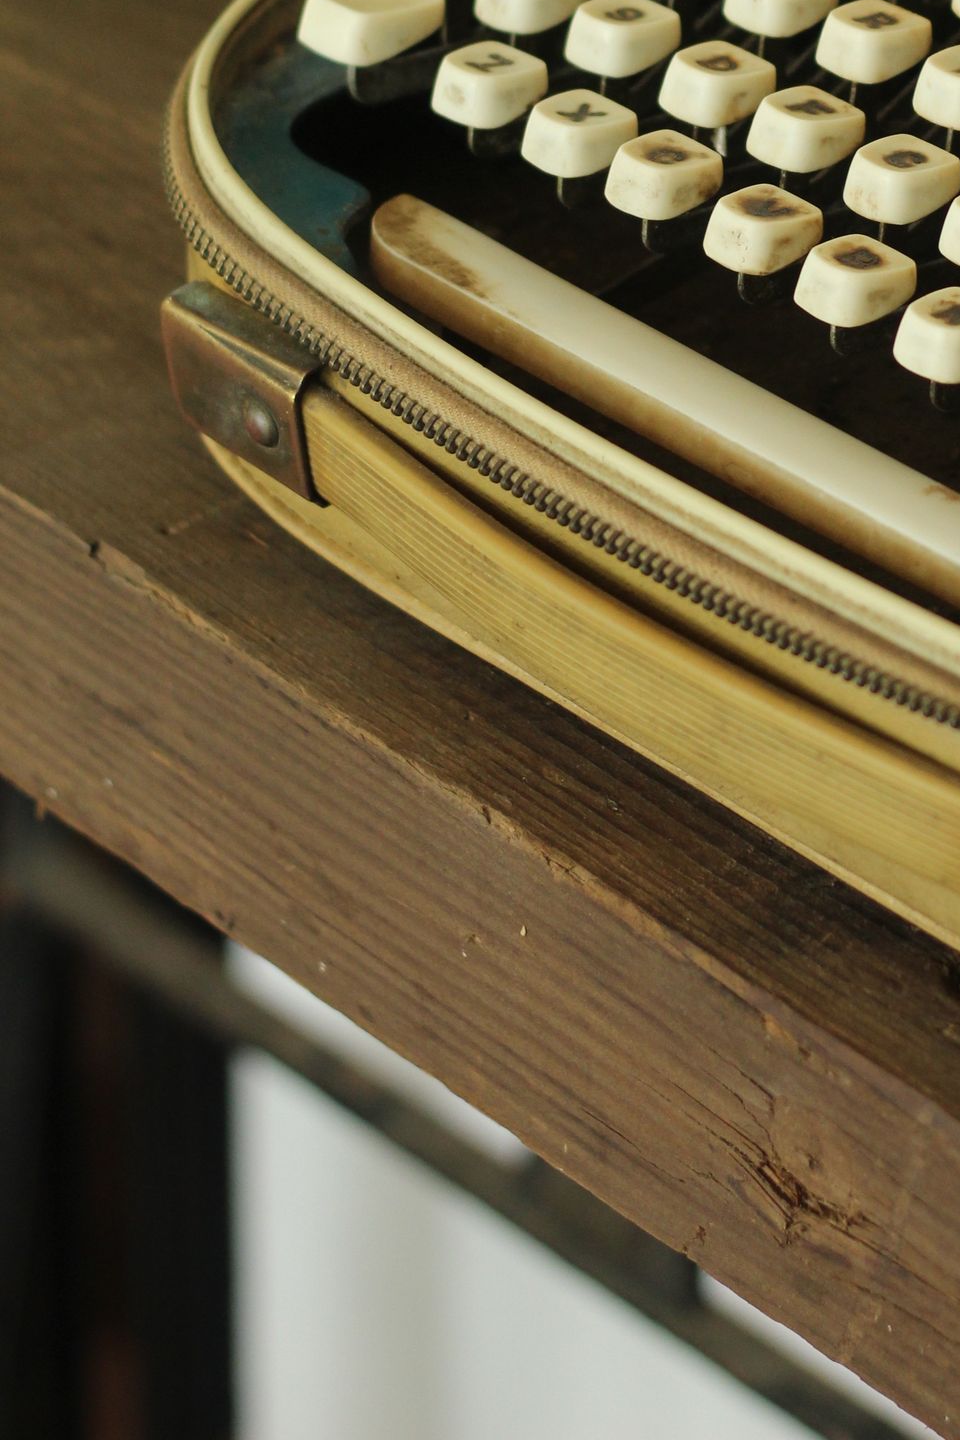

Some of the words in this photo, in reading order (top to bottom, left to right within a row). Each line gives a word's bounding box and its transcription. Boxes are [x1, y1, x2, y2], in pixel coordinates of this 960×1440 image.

[852, 12, 899, 29] R
[463, 52, 515, 73] Z
[555, 102, 608, 123] X
[695, 54, 738, 72] D
[784, 99, 838, 116] F
